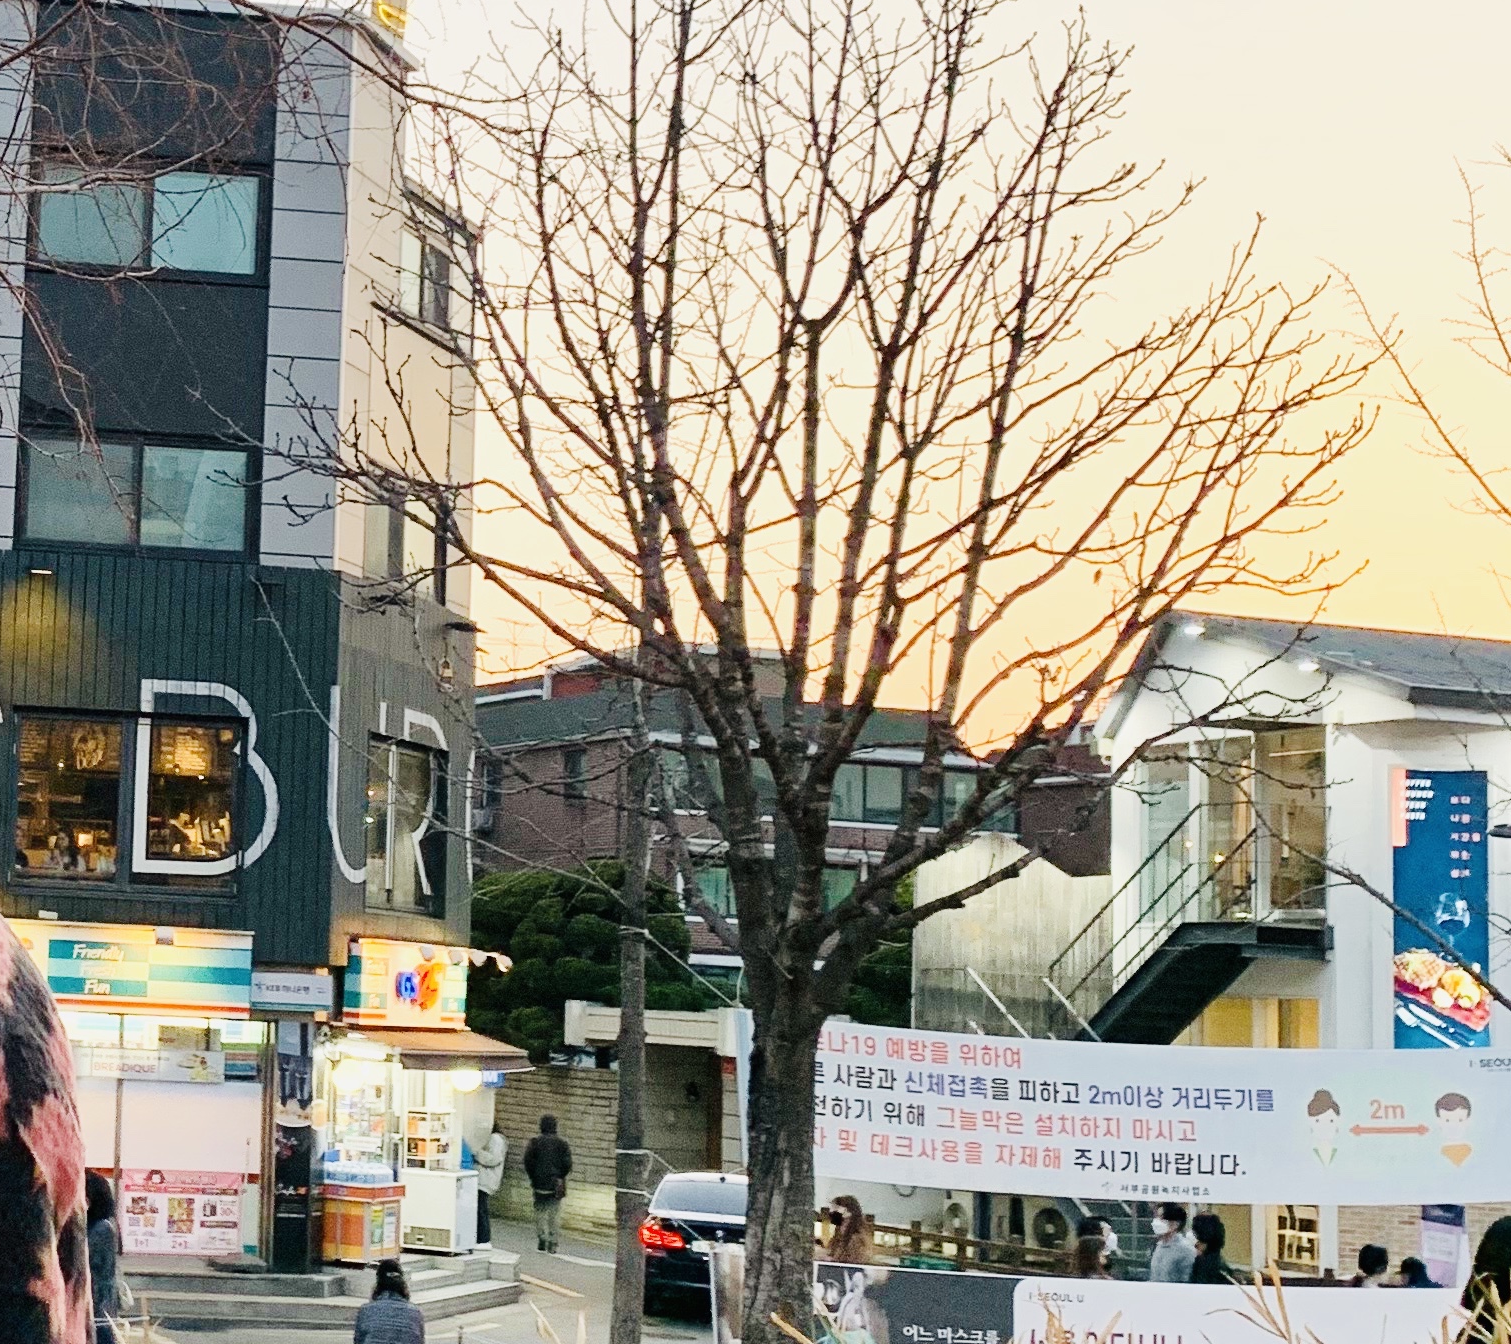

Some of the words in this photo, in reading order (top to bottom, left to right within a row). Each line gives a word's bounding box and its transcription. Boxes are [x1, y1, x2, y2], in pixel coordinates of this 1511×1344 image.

[72, 943, 125, 962] Friendly
[84, 978, 111, 996] Fun
[886, 1037, 949, 1065] 예방을
[959, 1043, 1022, 1069] 위하여
[833, 1063, 897, 1092] 사람과
[904, 1070, 1010, 1102] 신체접촉을
[1018, 1078, 1080, 1104] 피하고
[1088, 1084, 1164, 1109] 2m이상
[1172, 1086, 1274, 1112] 거리두기를
[883, 1101, 925, 1127] 위해
[936, 1106, 1024, 1136] 그늘막은
[1034, 1113, 1121, 1140] 설치하지
[1132, 1118, 1197, 1143] 마시고
[1369, 1099, 1405, 1120] 2m
[838, 1128, 857, 1152] 및
[870, 1132, 983, 1165] 데크사용을
[995, 1143, 1062, 1170] 자제해
[1073, 1148, 1139, 1174] 주시기
[1151, 1152, 1247, 1177] 바랍니다.
[902, 1324, 935, 1343] 어느
